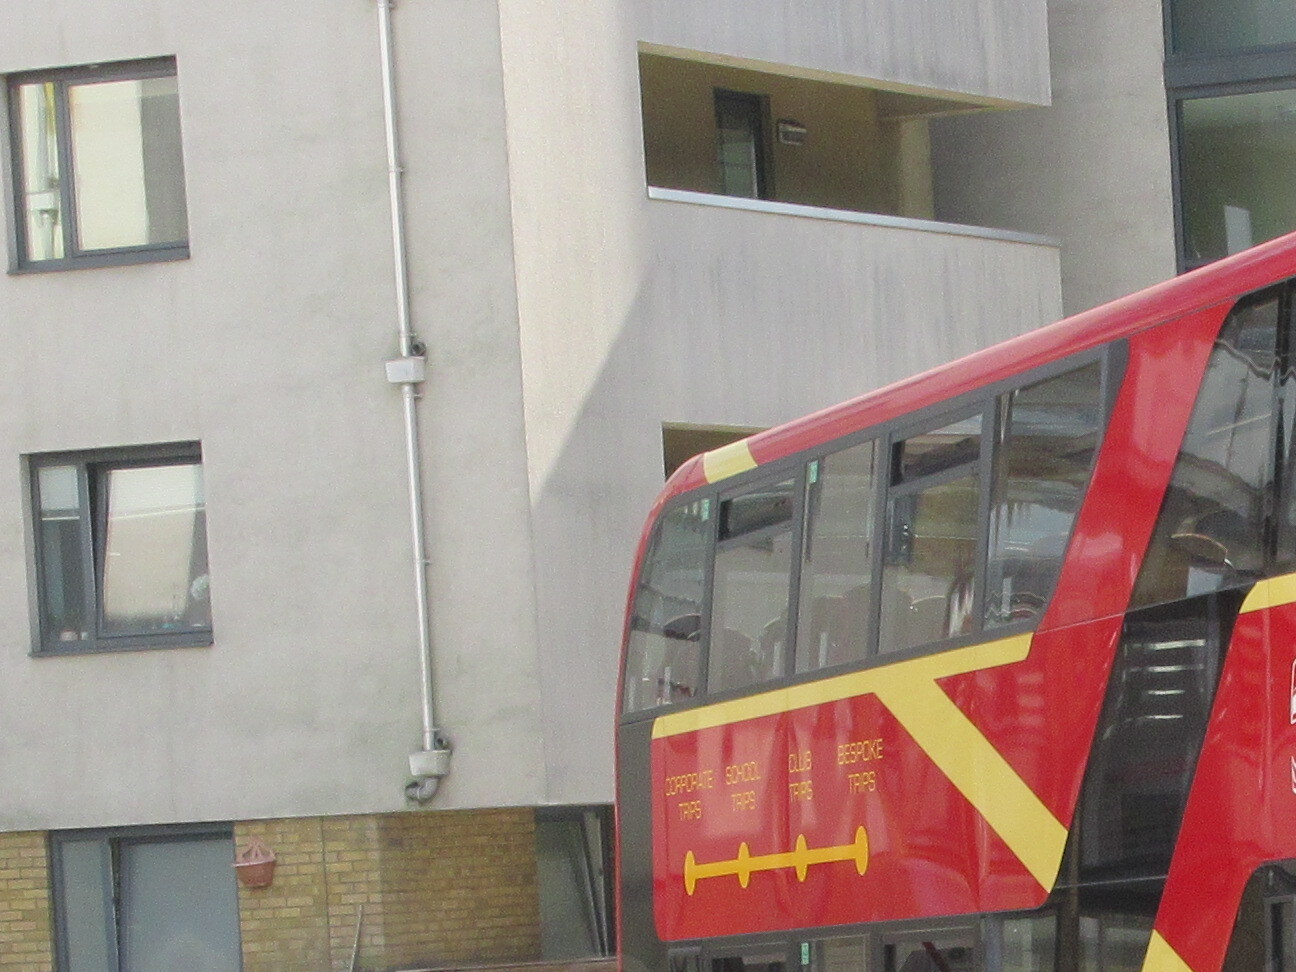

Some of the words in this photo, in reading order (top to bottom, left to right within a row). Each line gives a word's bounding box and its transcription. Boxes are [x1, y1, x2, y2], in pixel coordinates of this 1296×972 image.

[789, 750, 812, 773] CLUB
[837, 738, 884, 765] BESPOKE
[665, 770, 714, 796] CORPORATE
[725, 761, 761, 785] SCHOOL
[848, 771, 876, 794] TRIPS
[731, 790, 756, 811] TRIPS
[789, 780, 813, 801] TRIPS
[678, 800, 701, 821] TRIPS
